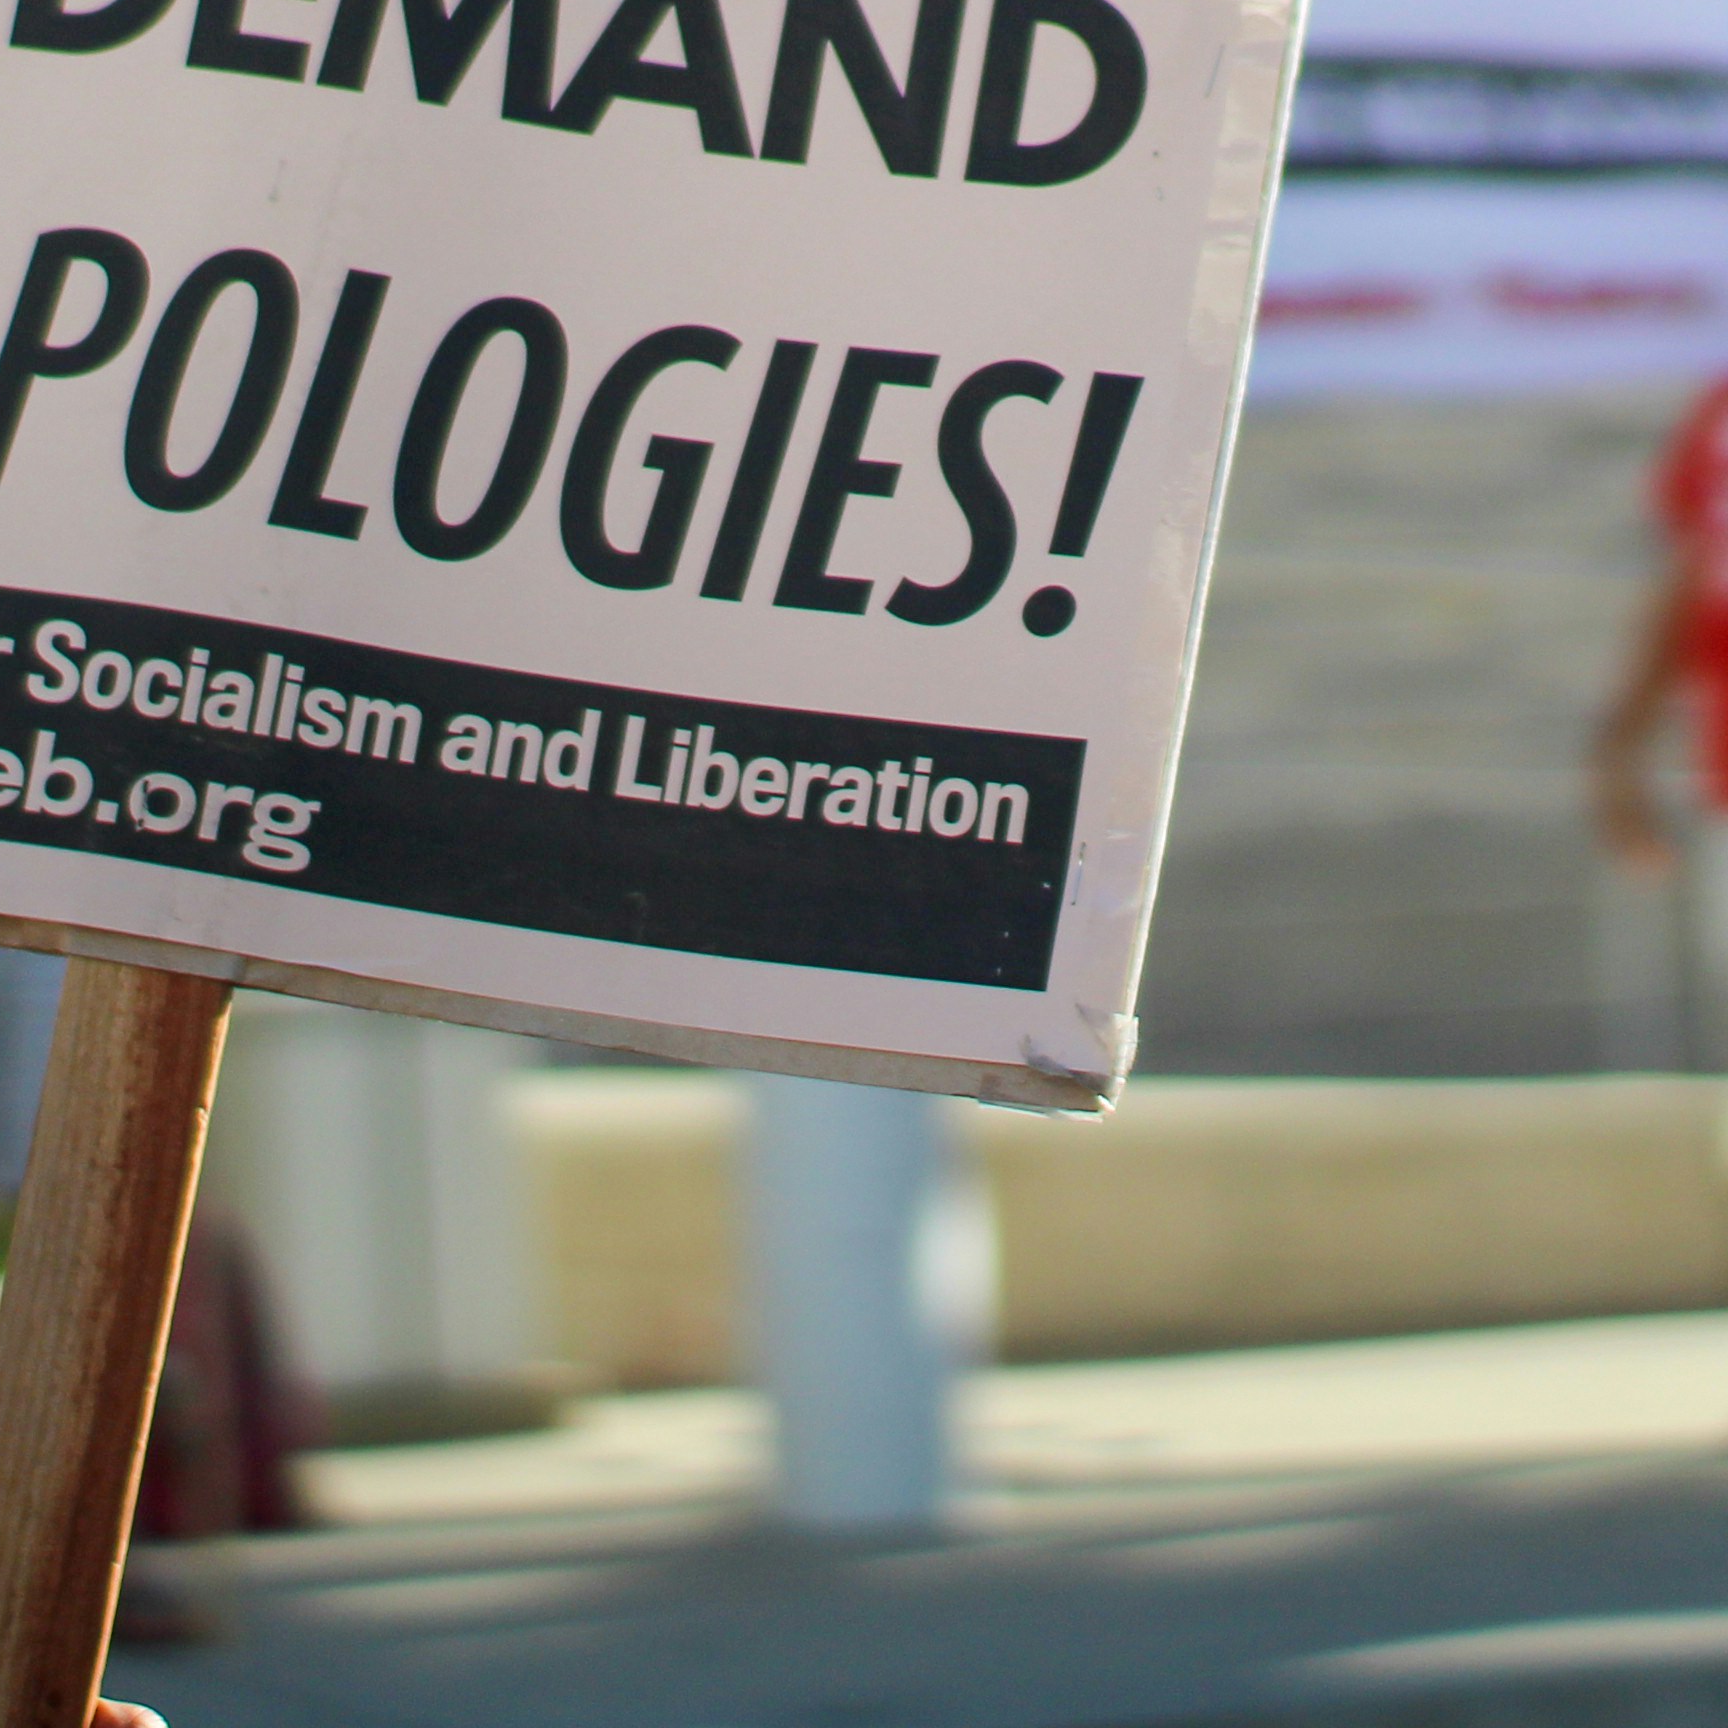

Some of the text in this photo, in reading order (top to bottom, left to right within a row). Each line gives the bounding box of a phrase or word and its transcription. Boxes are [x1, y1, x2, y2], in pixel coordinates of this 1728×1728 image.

[28, 621, 421, 762] Socialism
[441, 709, 601, 790] and
[616, 716, 1028, 843] Liberation
